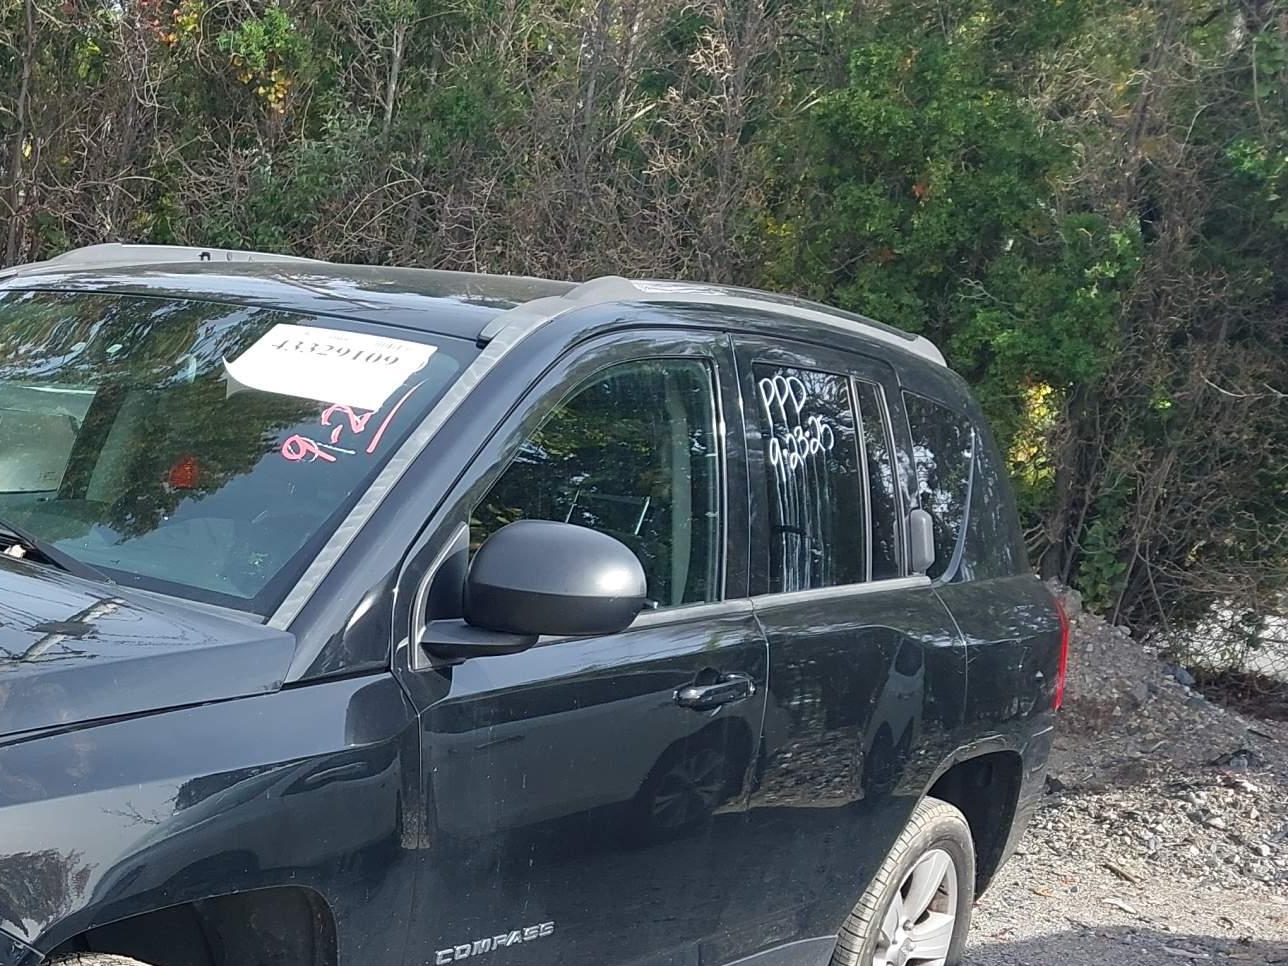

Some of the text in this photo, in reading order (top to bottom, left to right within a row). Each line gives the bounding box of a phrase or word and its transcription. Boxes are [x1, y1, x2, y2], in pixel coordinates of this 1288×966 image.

[271, 338, 399, 366] 43329109
[759, 376, 807, 423] PPD
[435, 921, 555, 965] COMPASS
